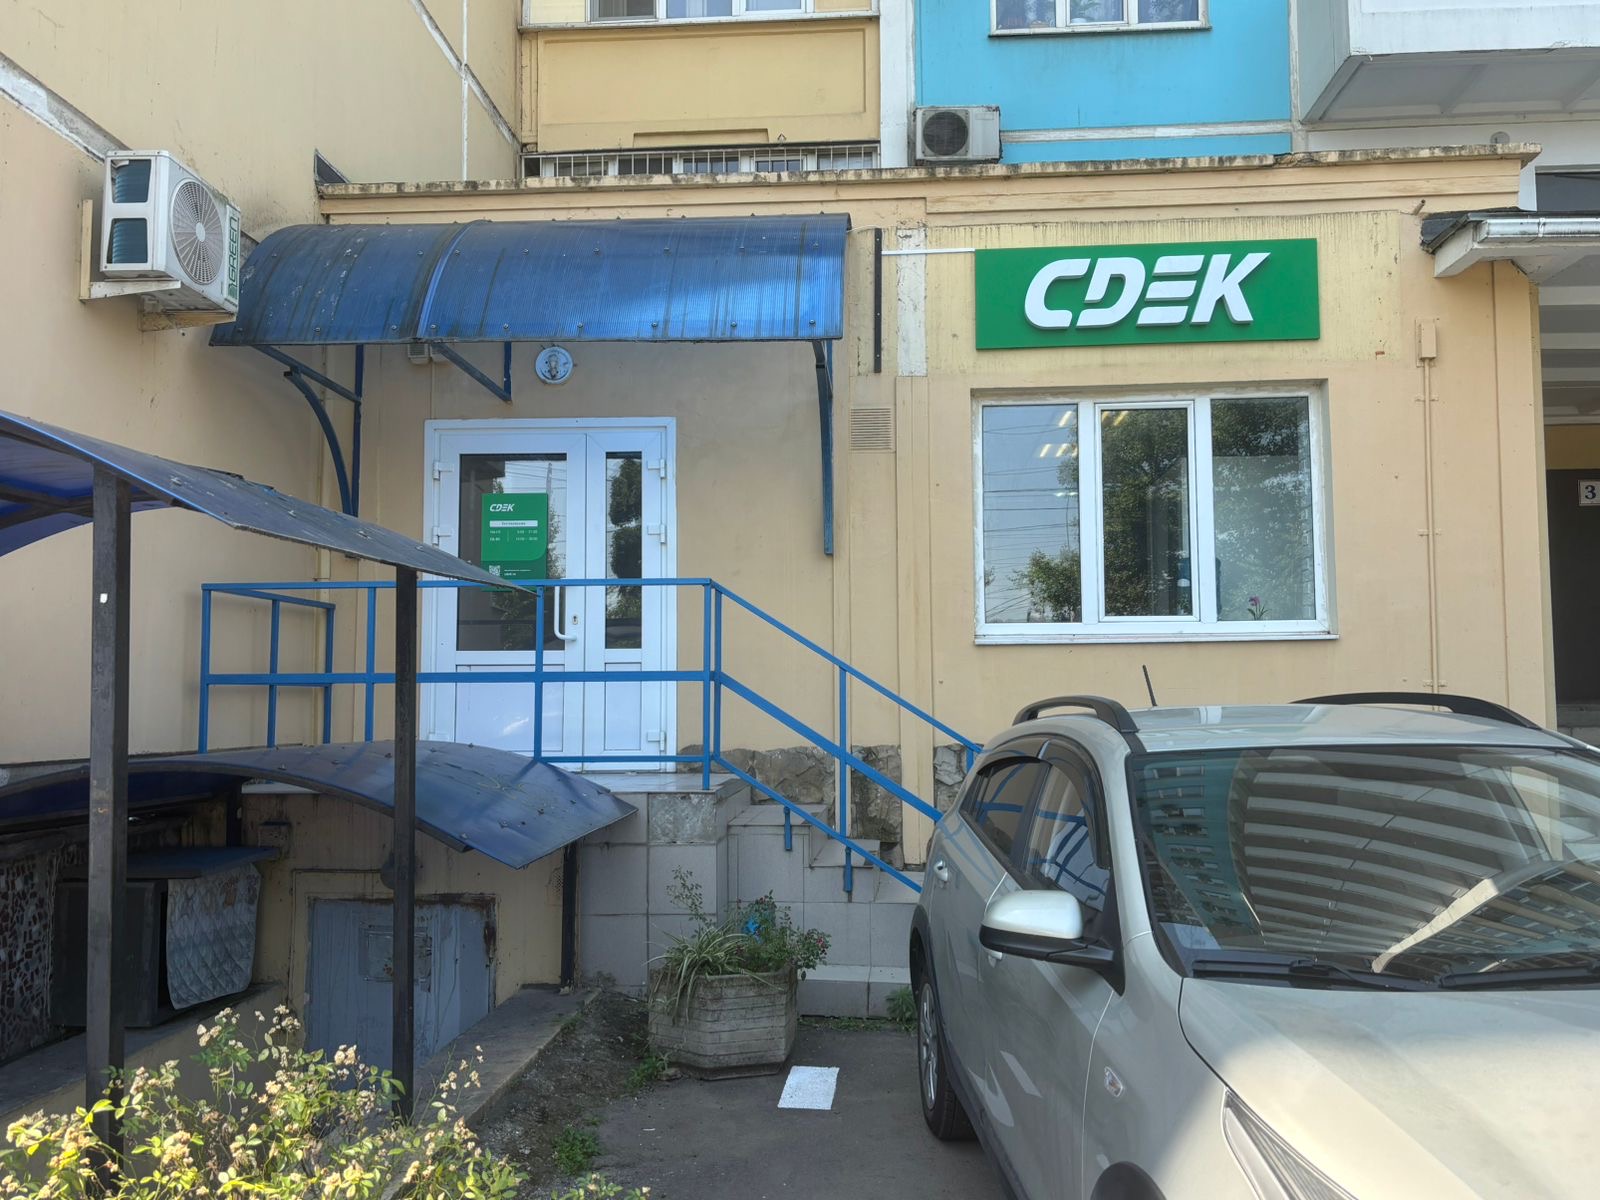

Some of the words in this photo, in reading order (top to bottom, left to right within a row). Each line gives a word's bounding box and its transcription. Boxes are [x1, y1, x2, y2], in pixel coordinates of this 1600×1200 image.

[228, 216, 237, 283] GREEN
[1024, 252, 1271, 329] CDEK
[490, 503, 515, 512] CDEK
[1584, 485, 1597, 500] 3
